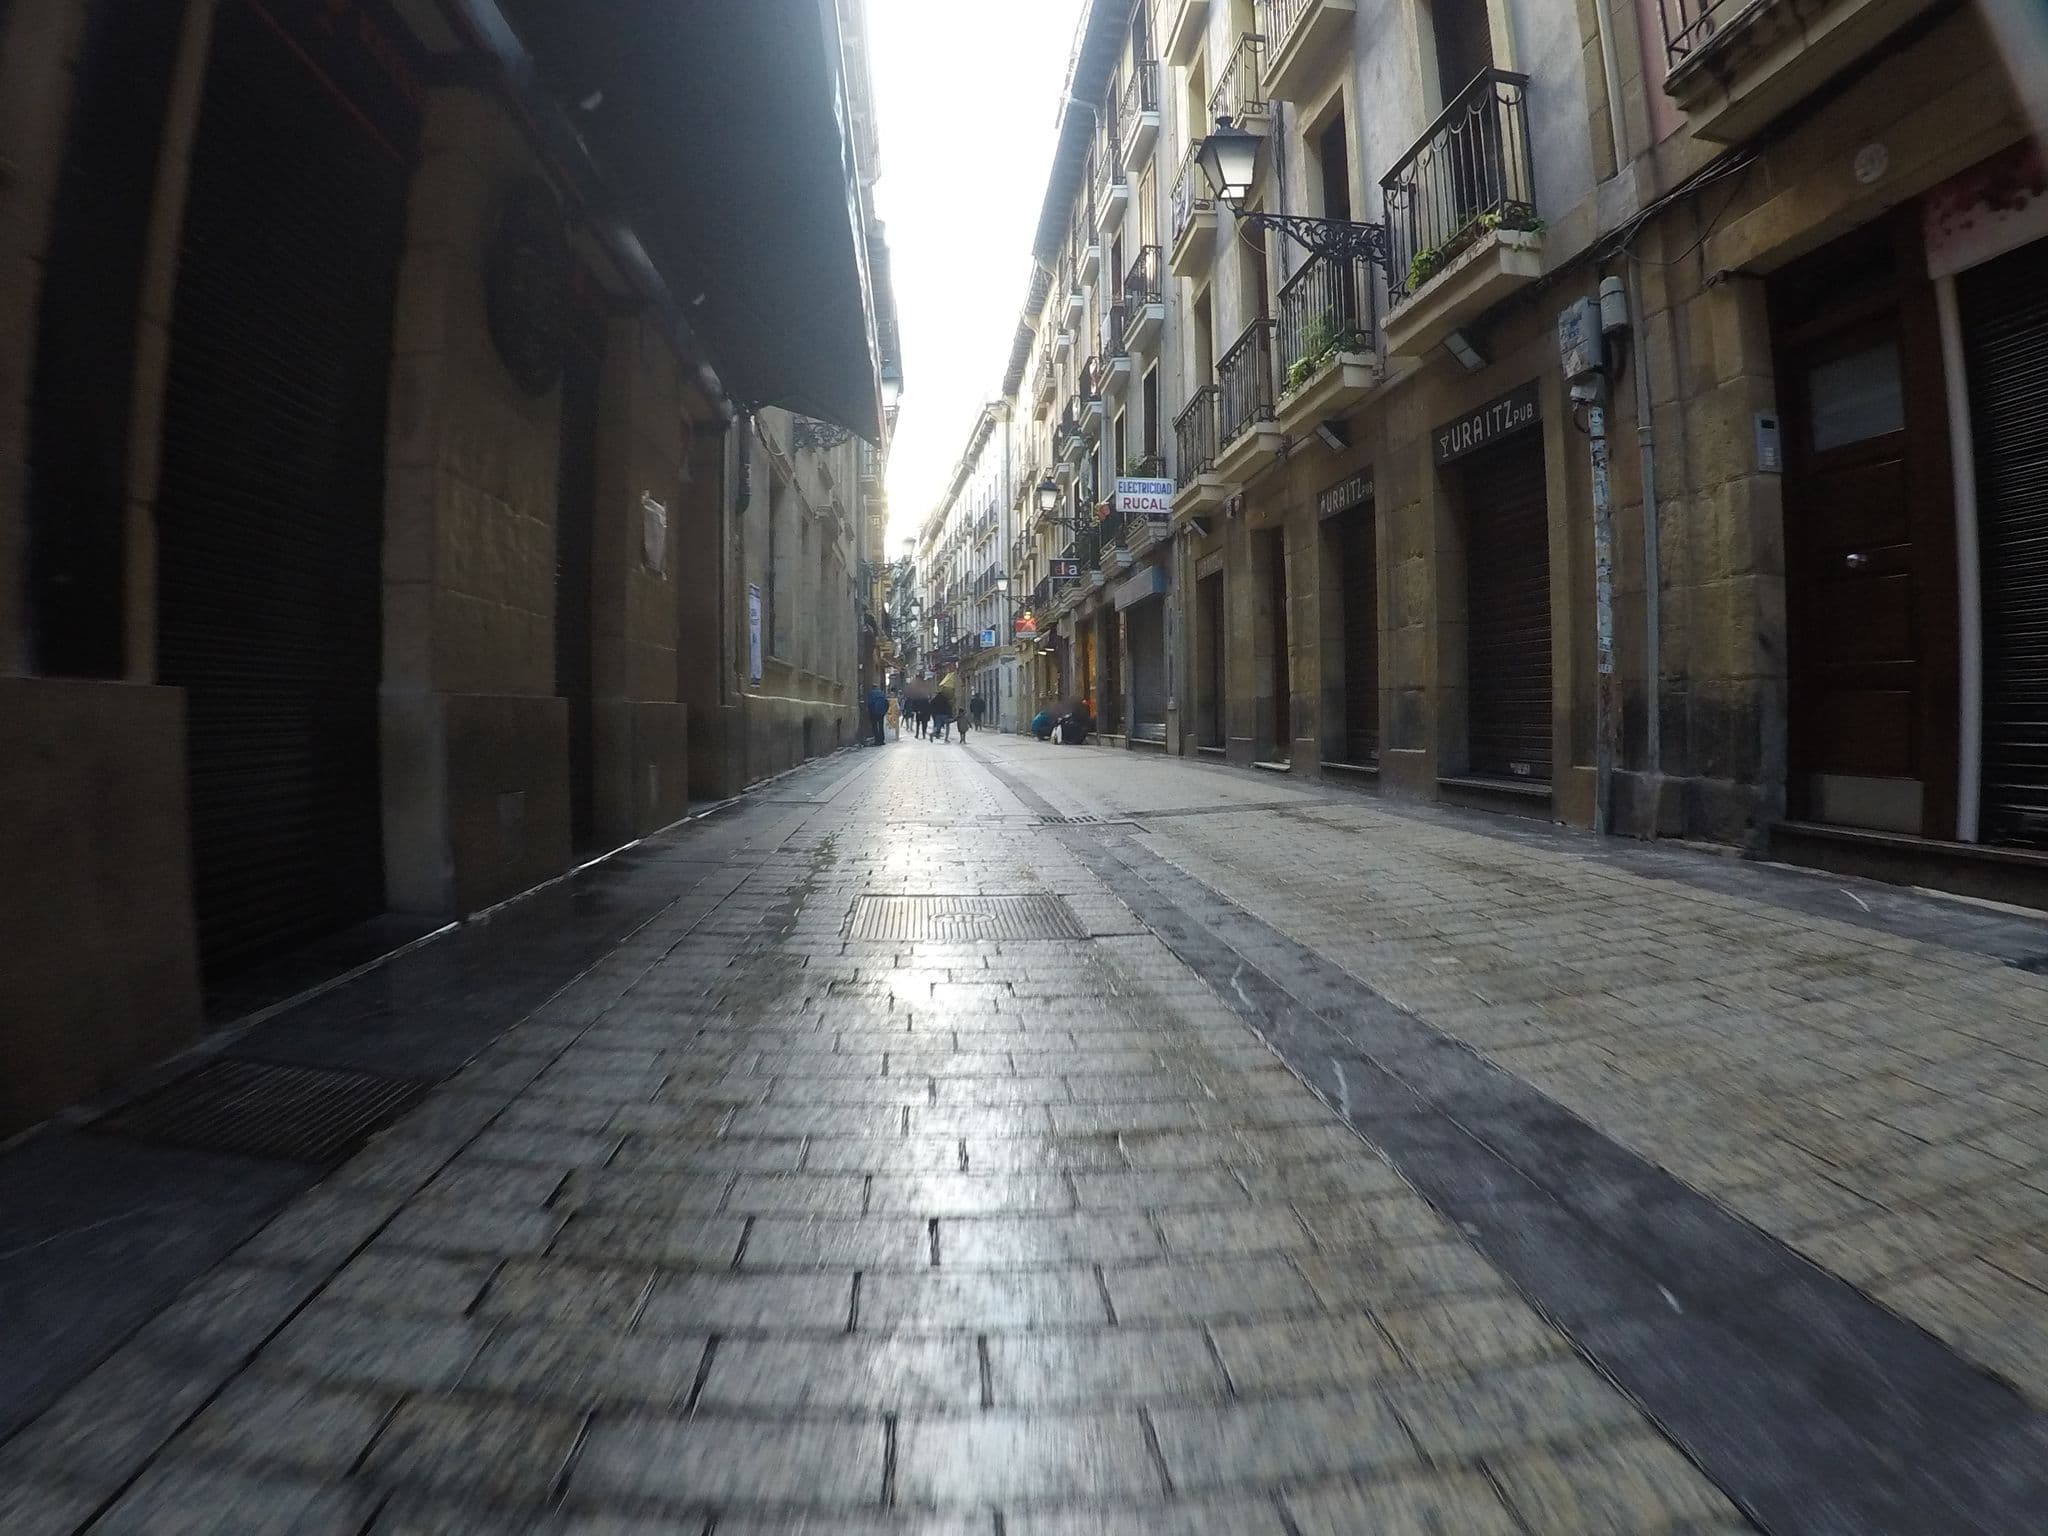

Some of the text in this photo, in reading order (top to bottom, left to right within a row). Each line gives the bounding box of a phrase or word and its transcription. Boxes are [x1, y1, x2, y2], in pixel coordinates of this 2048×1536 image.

[1513, 403, 1534, 424] PUB
[1118, 481, 1172, 495] ELECTRICIDAD
[1123, 497, 1168, 510] RUCAL
